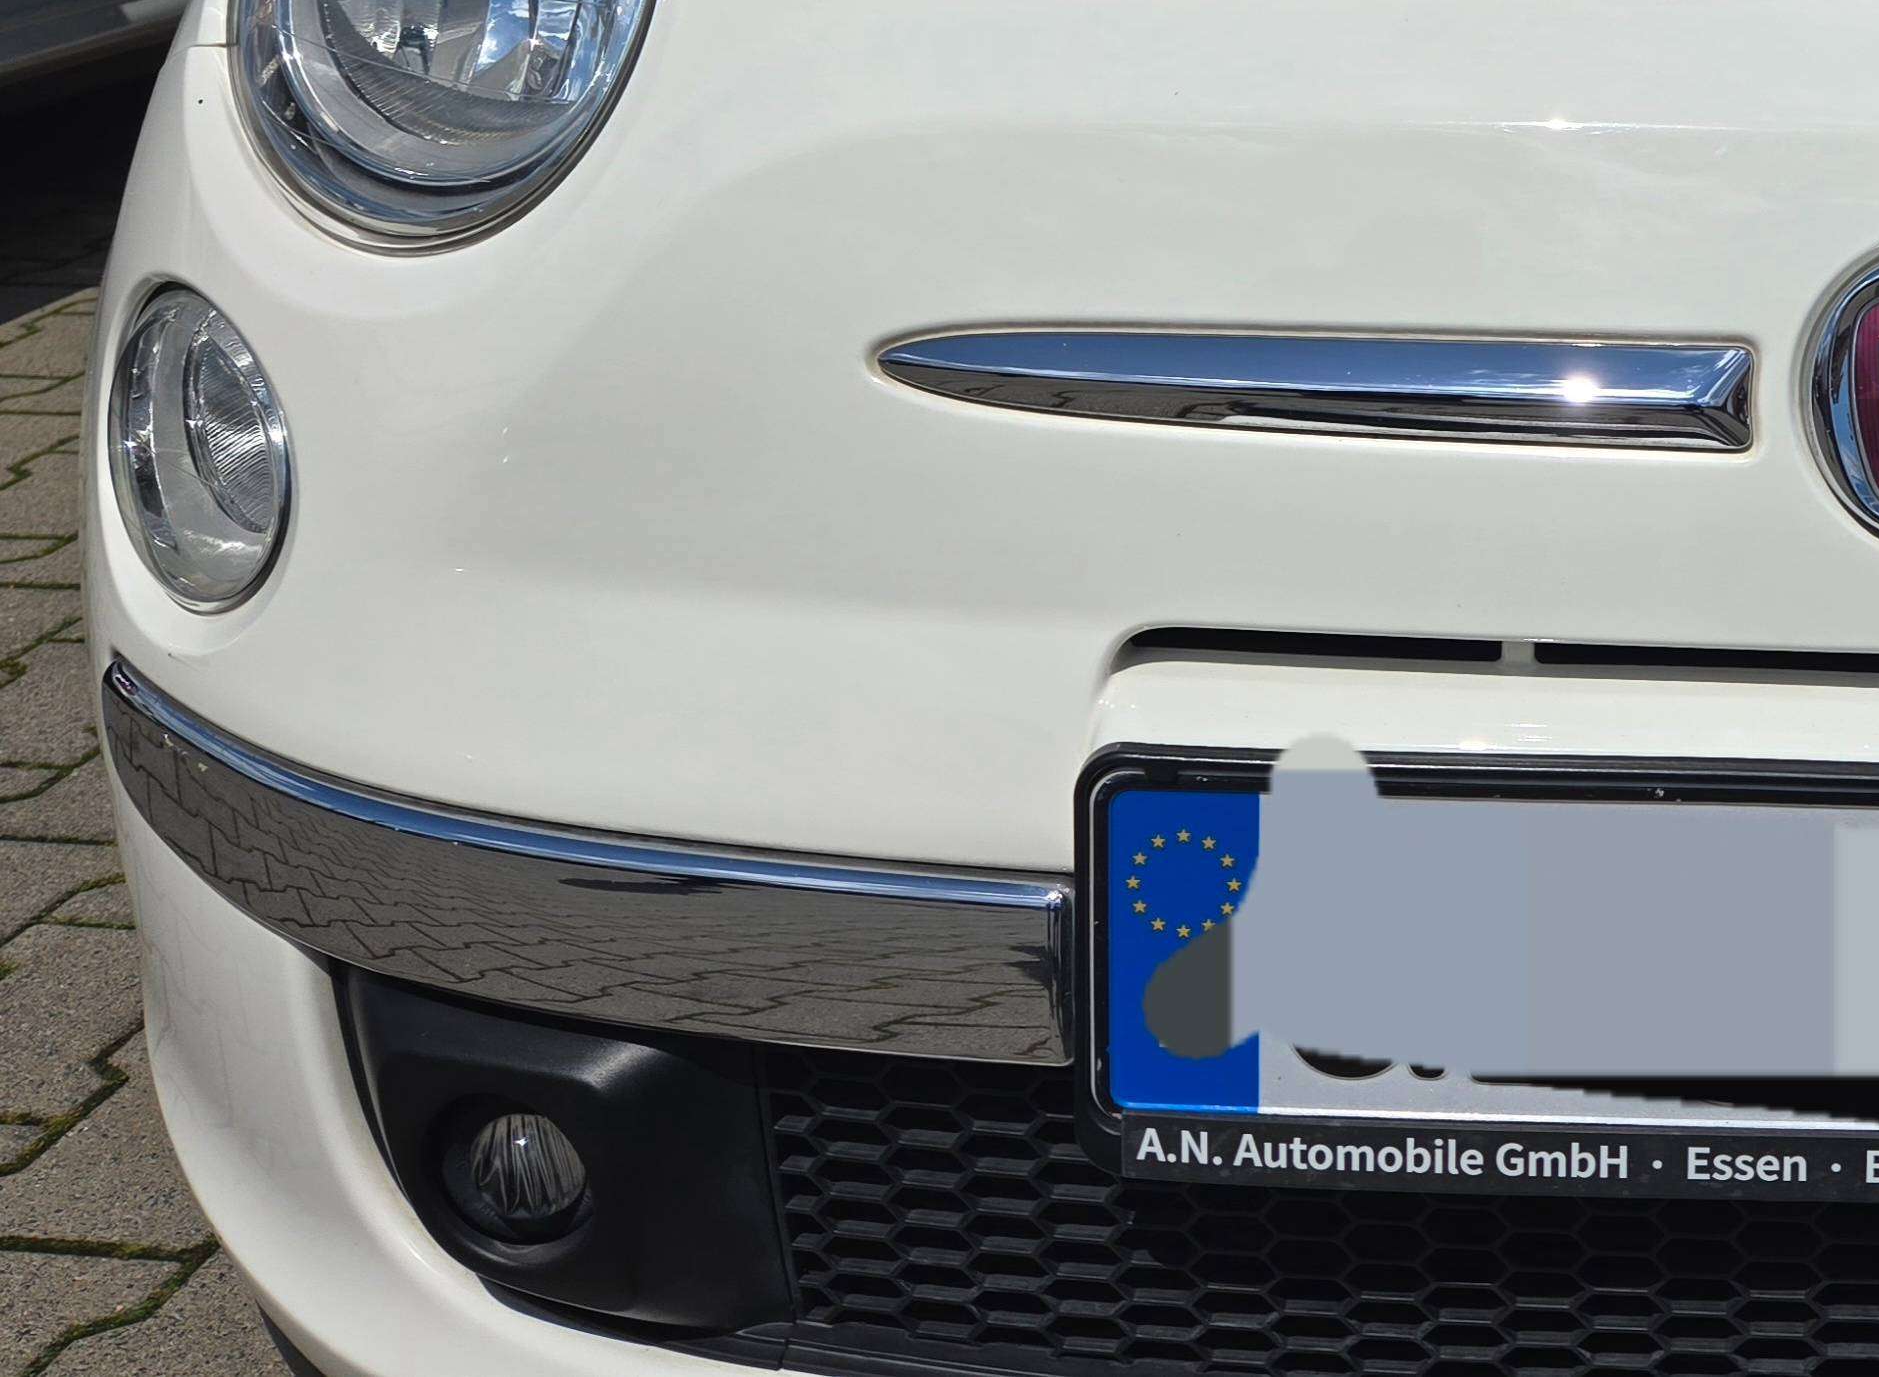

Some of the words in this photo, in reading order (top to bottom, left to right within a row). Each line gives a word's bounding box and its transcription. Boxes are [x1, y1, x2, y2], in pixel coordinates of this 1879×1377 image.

[1136, 1127, 1223, 1166] A.N.
[1233, 1133, 1484, 1176] Automobile
[1495, 1142, 1628, 1179] GmbH
[1687, 1146, 1807, 1182] Essen
